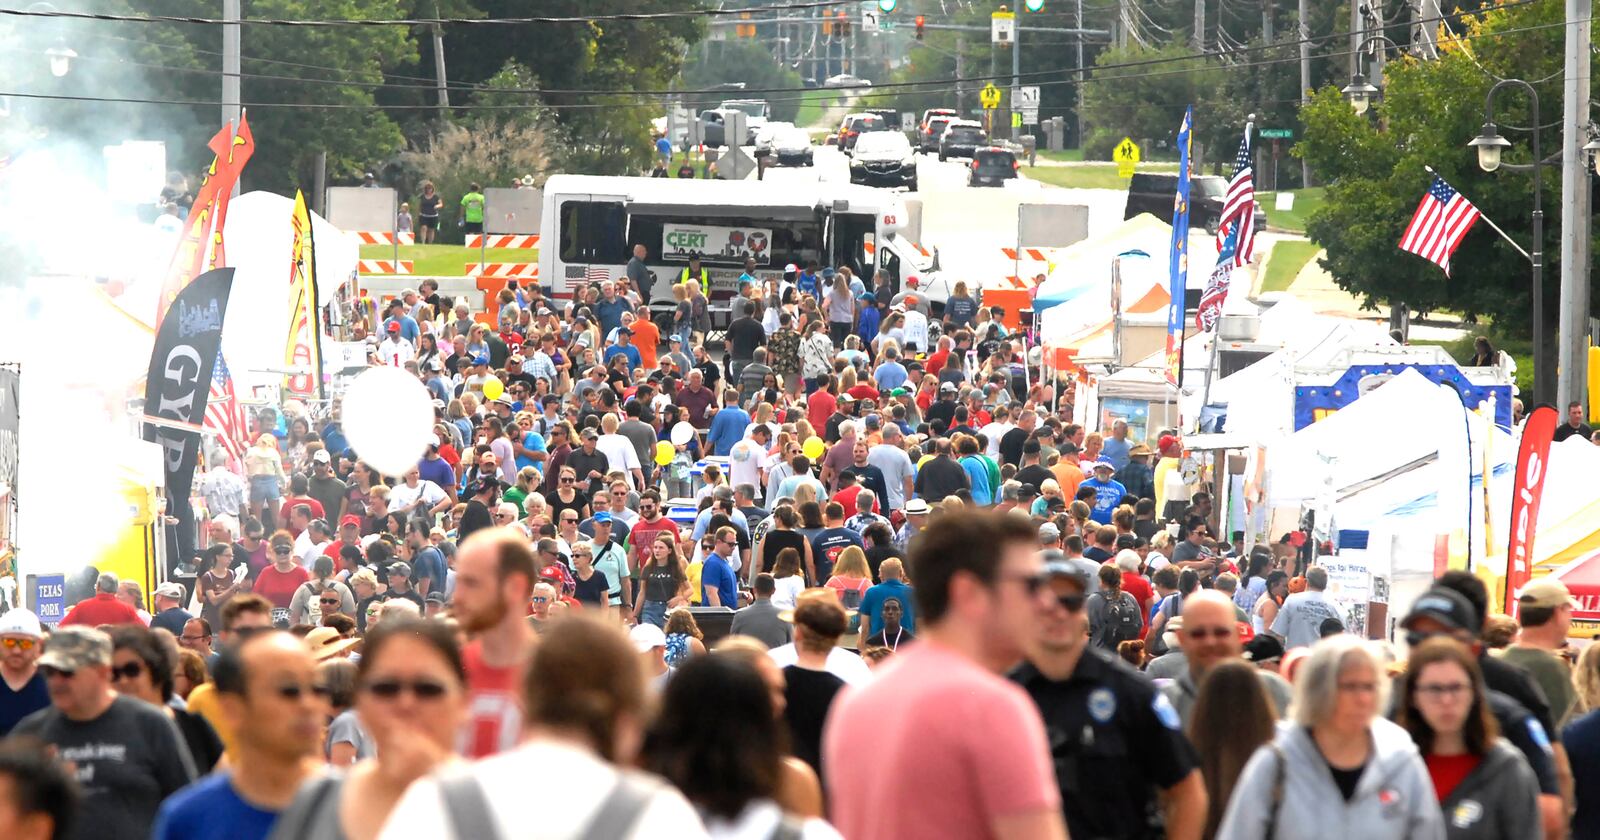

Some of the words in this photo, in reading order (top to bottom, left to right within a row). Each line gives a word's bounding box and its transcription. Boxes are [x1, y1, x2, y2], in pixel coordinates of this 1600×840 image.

[666, 232, 708, 248] CERT
[38, 584, 63, 598] TEXAS
[40, 603, 60, 616] PORK
